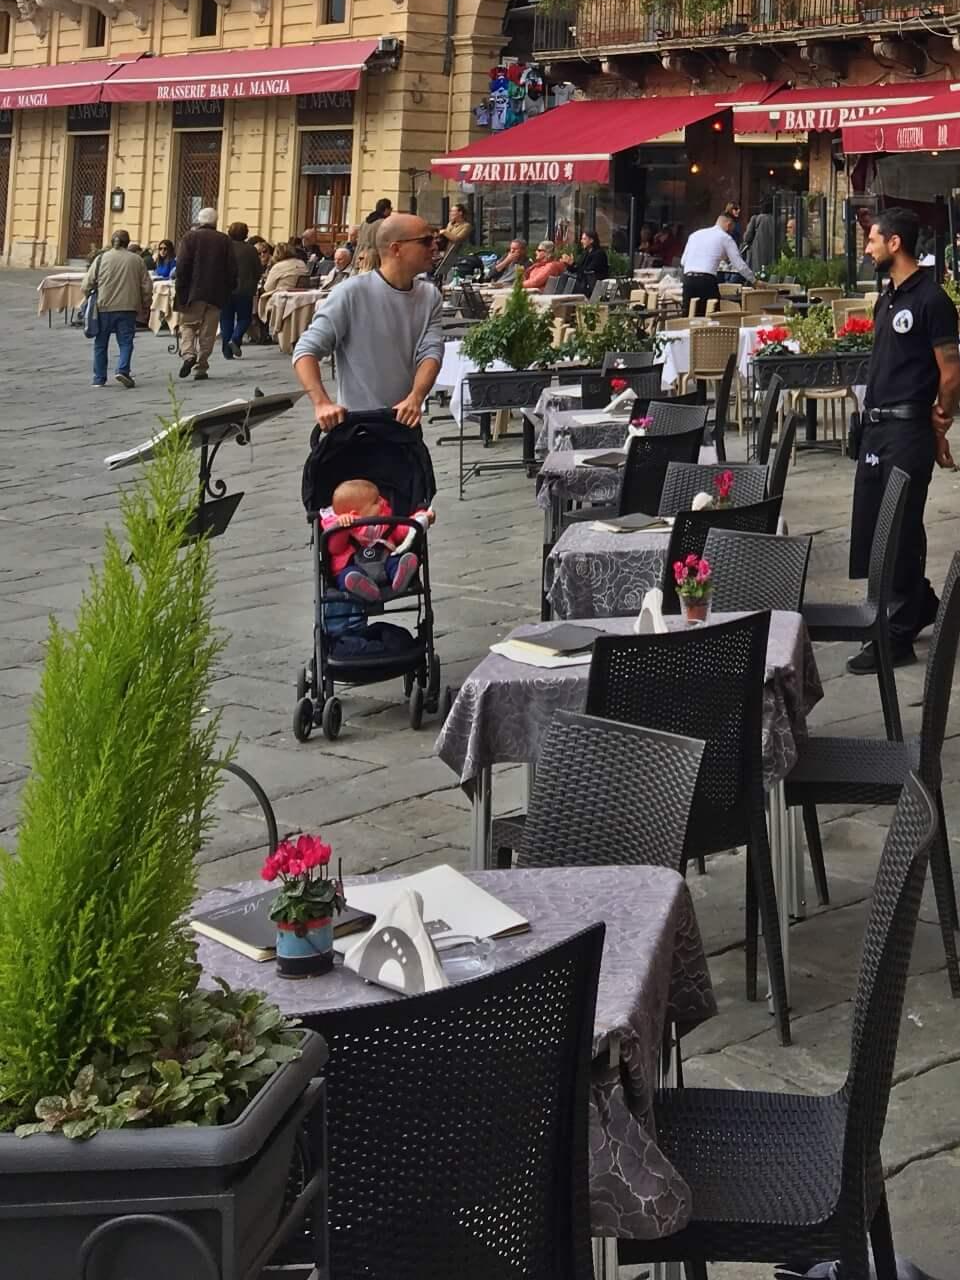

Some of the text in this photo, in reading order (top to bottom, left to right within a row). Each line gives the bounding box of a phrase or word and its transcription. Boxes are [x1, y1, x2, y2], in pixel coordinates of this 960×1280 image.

[17, 92, 48, 107] MANGIA
[156, 79, 291, 100] BRASSERIE BAR AL MANGIA
[784, 110, 816, 129] BAR
[818, 109, 836, 129] IL
[470, 161, 560, 181] BAR IL PALIO
